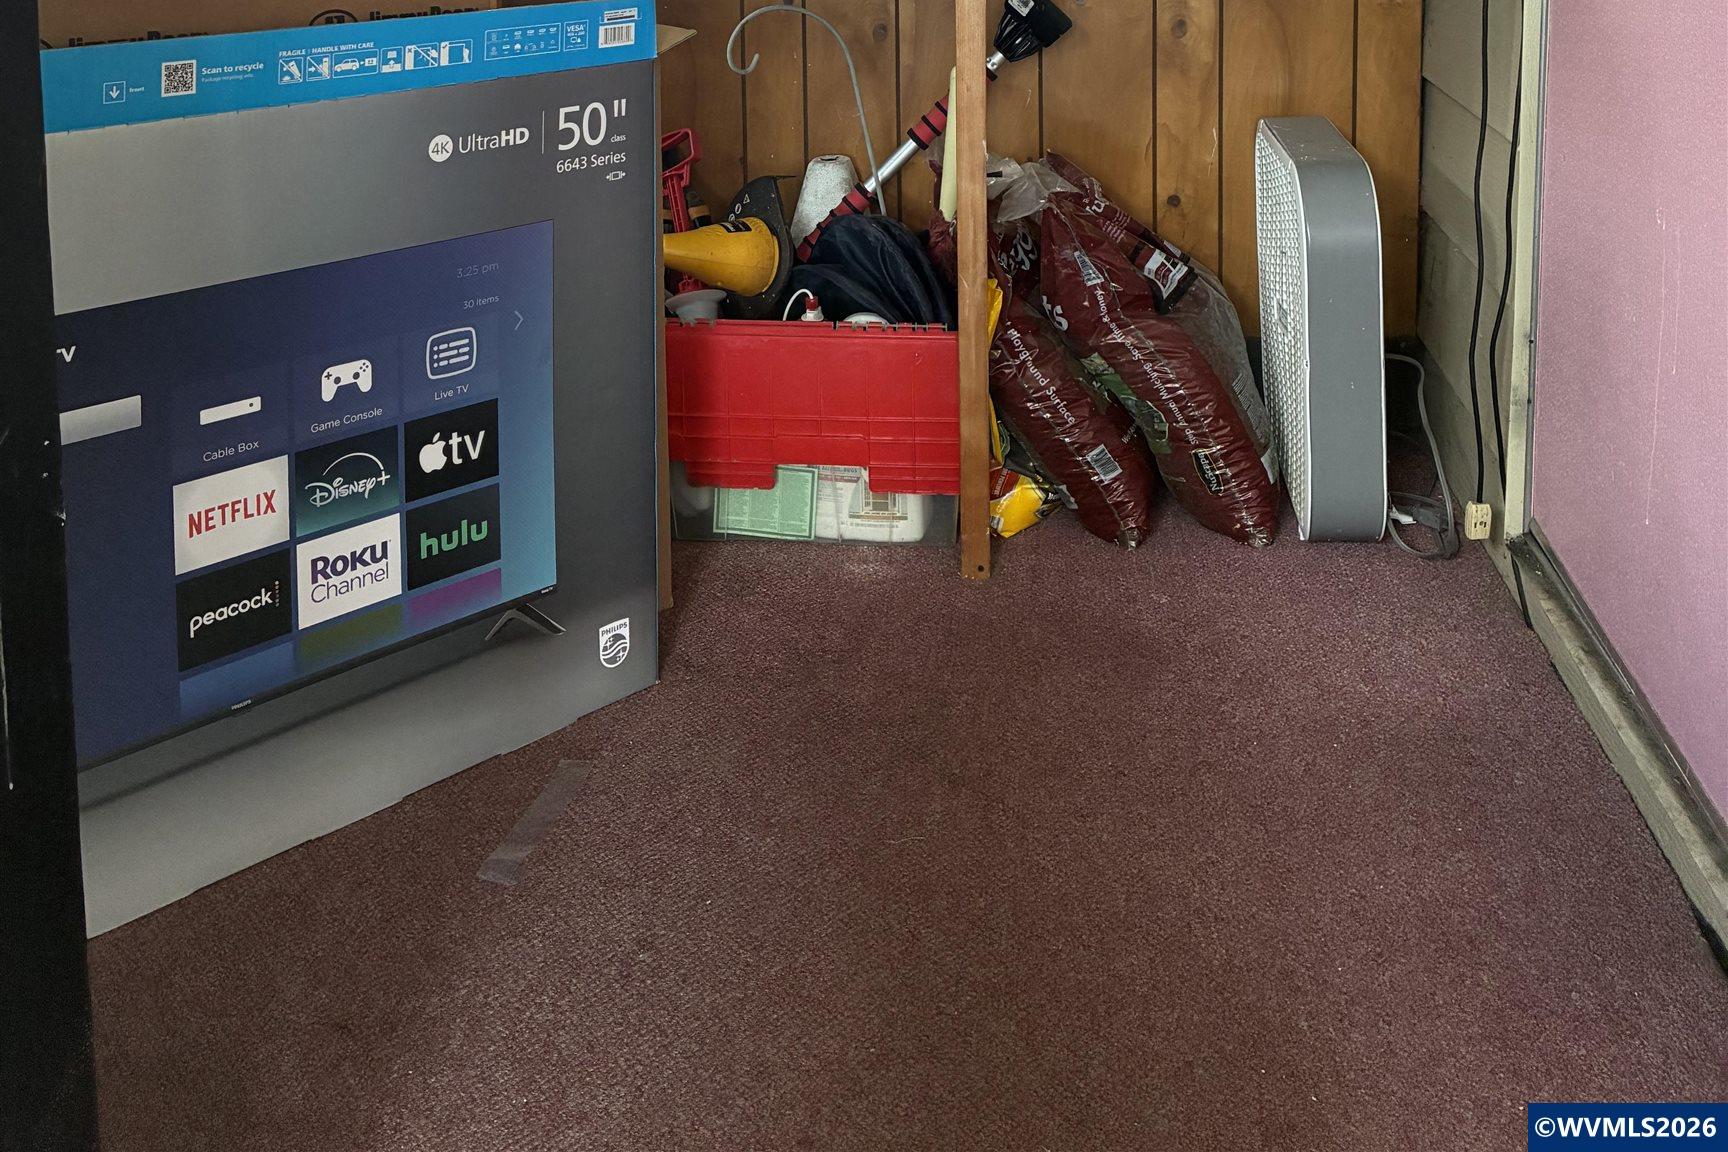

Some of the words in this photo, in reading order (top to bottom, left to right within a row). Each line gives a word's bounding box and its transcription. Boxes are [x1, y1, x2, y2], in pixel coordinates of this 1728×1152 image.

[566, 24, 584, 32] VESA
[278, 49, 306, 58] FRAGILE
[312, 46, 339, 54] HANDLE
[357, 42, 375, 50] CARE
[201, 66, 222, 76] Scan
[224, 64, 234, 73] to
[234, 61, 265, 73] recycle
[431, 140, 450, 156] 4K
[610, 133, 627, 143] class
[556, 156, 587, 173] 6643
[590, 151, 626, 167] Series
[482, 262, 499, 274] pm
[463, 299, 474, 310] 30
[1101, 314, 1110, 324] &
[1110, 322, 1126, 343] Time
[1125, 341, 1142, 361] Save
[1006, 327, 1050, 387] Playground
[1045, 386, 1076, 425] Surface
[1143, 362, 1169, 400] Mulching
[434, 387, 454, 401] Live
[456, 384, 470, 395] TV
[310, 418, 341, 434] Game
[343, 407, 383, 425] Console
[1166, 399, 1189, 427] Annual
[203, 445, 235, 462] Cable
[238, 440, 260, 453] Box
[188, 489, 277, 539] NETFLIX
[420, 519, 489, 560] hulu
[311, 563, 389, 604] Channel
[189, 588, 273, 639] peacock
[601, 621, 628, 637] PHILIPS
